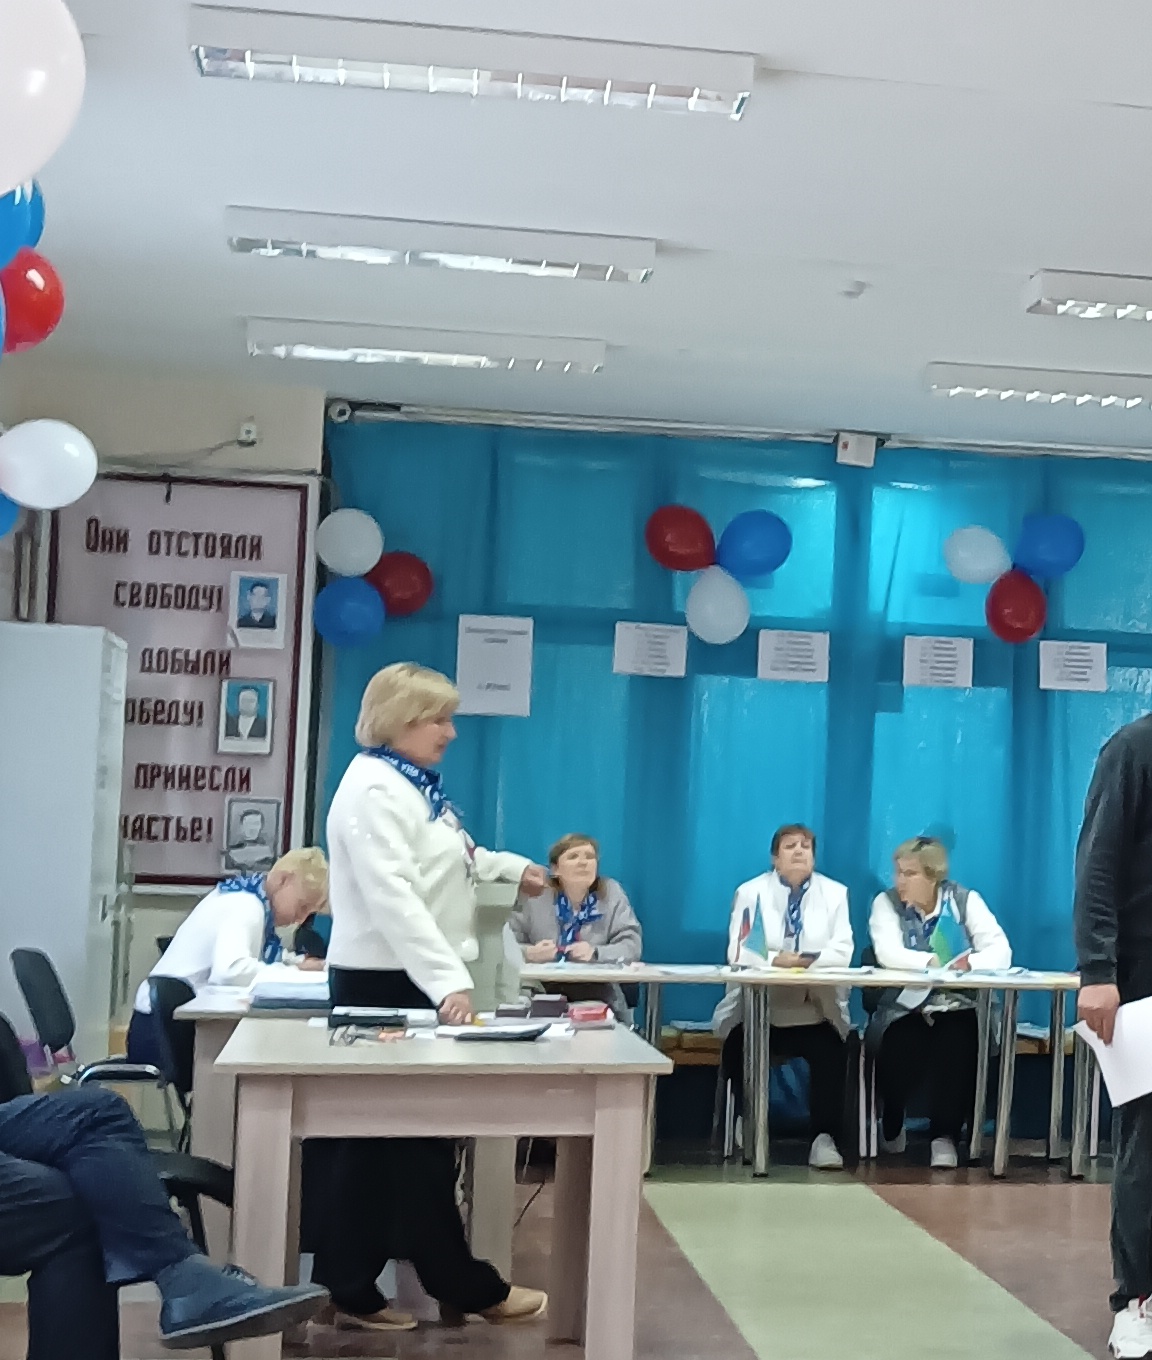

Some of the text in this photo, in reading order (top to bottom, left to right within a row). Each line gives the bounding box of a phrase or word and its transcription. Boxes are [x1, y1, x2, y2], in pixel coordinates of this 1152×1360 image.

[148, 529, 262, 561] отстояли
[140, 646, 231, 676] добыли
[125, 697, 204, 727] обеду!
[134, 762, 251, 793] принесли
